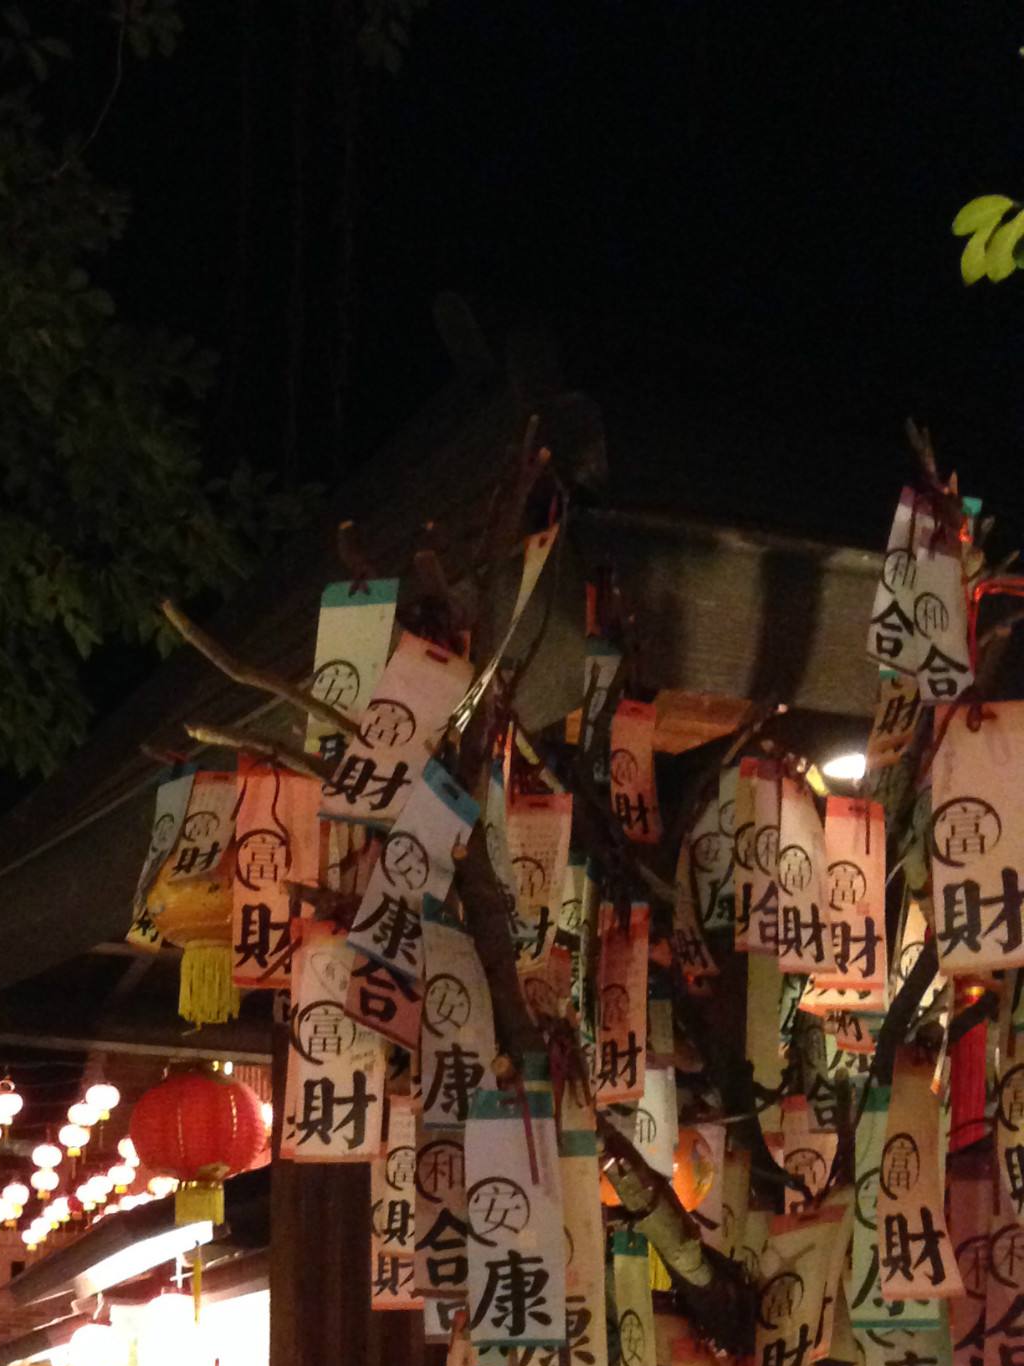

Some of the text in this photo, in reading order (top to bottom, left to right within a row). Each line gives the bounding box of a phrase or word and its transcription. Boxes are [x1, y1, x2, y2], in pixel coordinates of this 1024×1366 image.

[870, 600, 914, 658] 合
[917, 644, 969, 697] 合
[322, 754, 412, 811] 財
[173, 841, 222, 877] 財
[240, 833, 286, 886] 富
[936, 800, 994, 860] 富
[351, 892, 423, 966] 康
[777, 902, 827, 962] 財
[937, 866, 1024, 957] 財
[299, 1004, 351, 1060] 富
[598, 1031, 644, 1091] 財
[296, 1069, 378, 1149] 財
[424, 1043, 486, 1121] 康
[884, 1138, 916, 1196] 富
[470, 1181, 527, 1241] 安
[414, 1207, 469, 1285] 合
[882, 1206, 946, 1286] 財
[471, 1249, 553, 1337] 康
